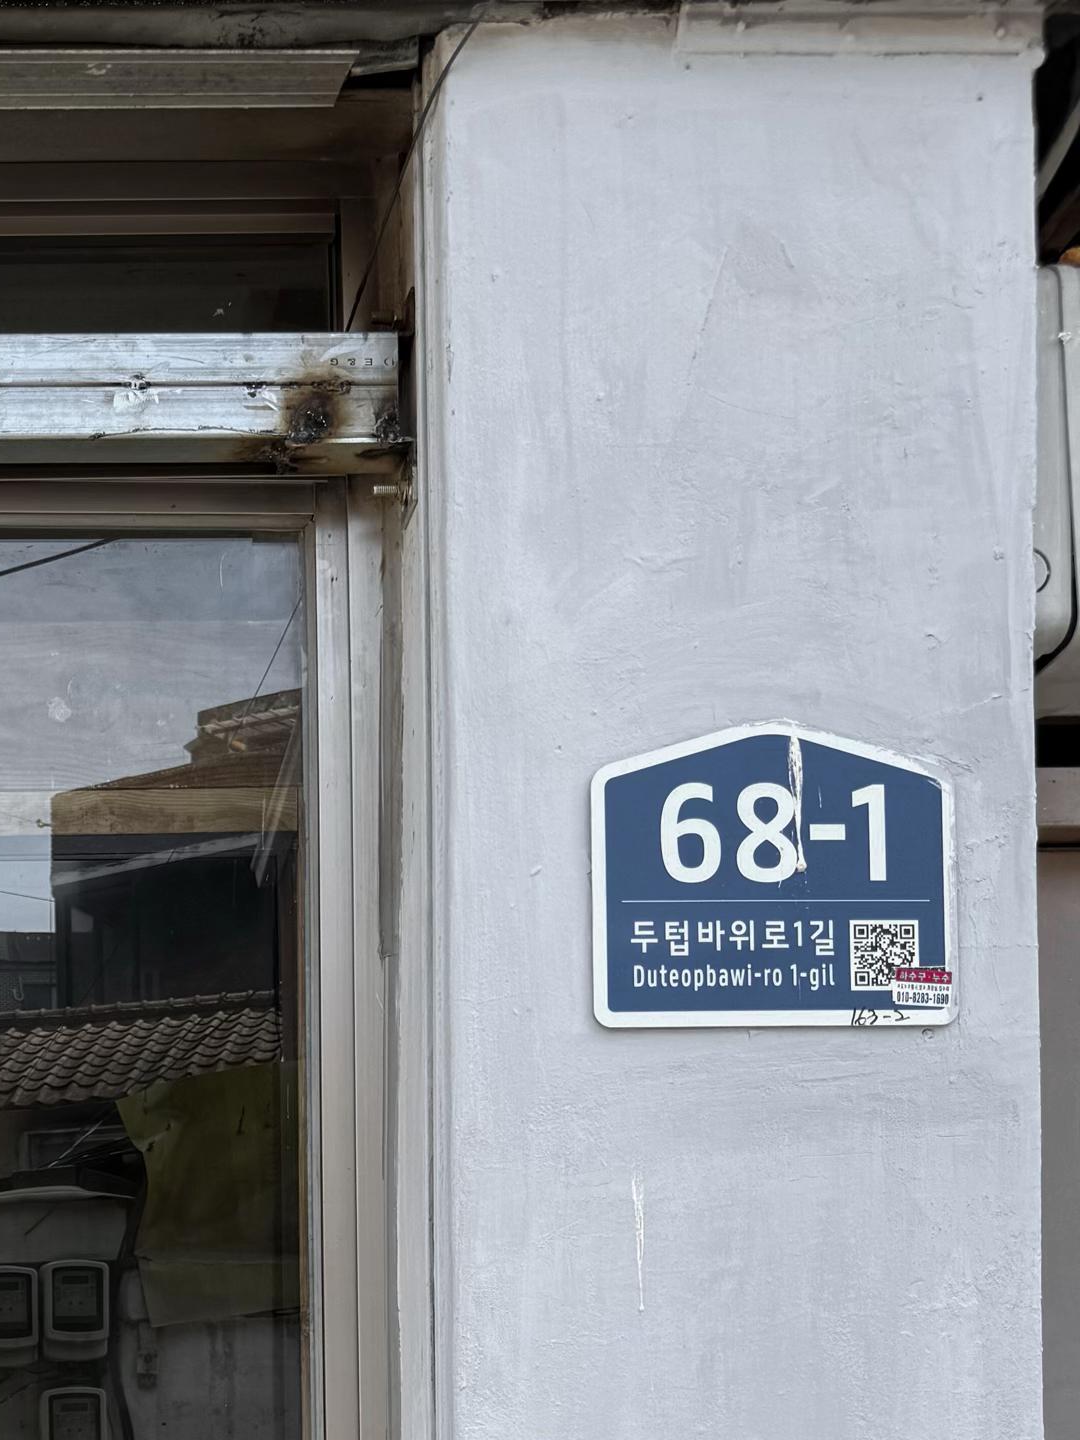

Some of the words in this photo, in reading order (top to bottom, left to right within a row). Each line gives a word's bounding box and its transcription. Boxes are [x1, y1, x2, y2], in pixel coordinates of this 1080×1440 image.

[661, 782, 887, 883] 68-1
[631, 920, 835, 956] 두텁바위로1길
[633, 964, 783, 992] Duteopbawi-ro
[790, 963, 836, 991] 1-gil
